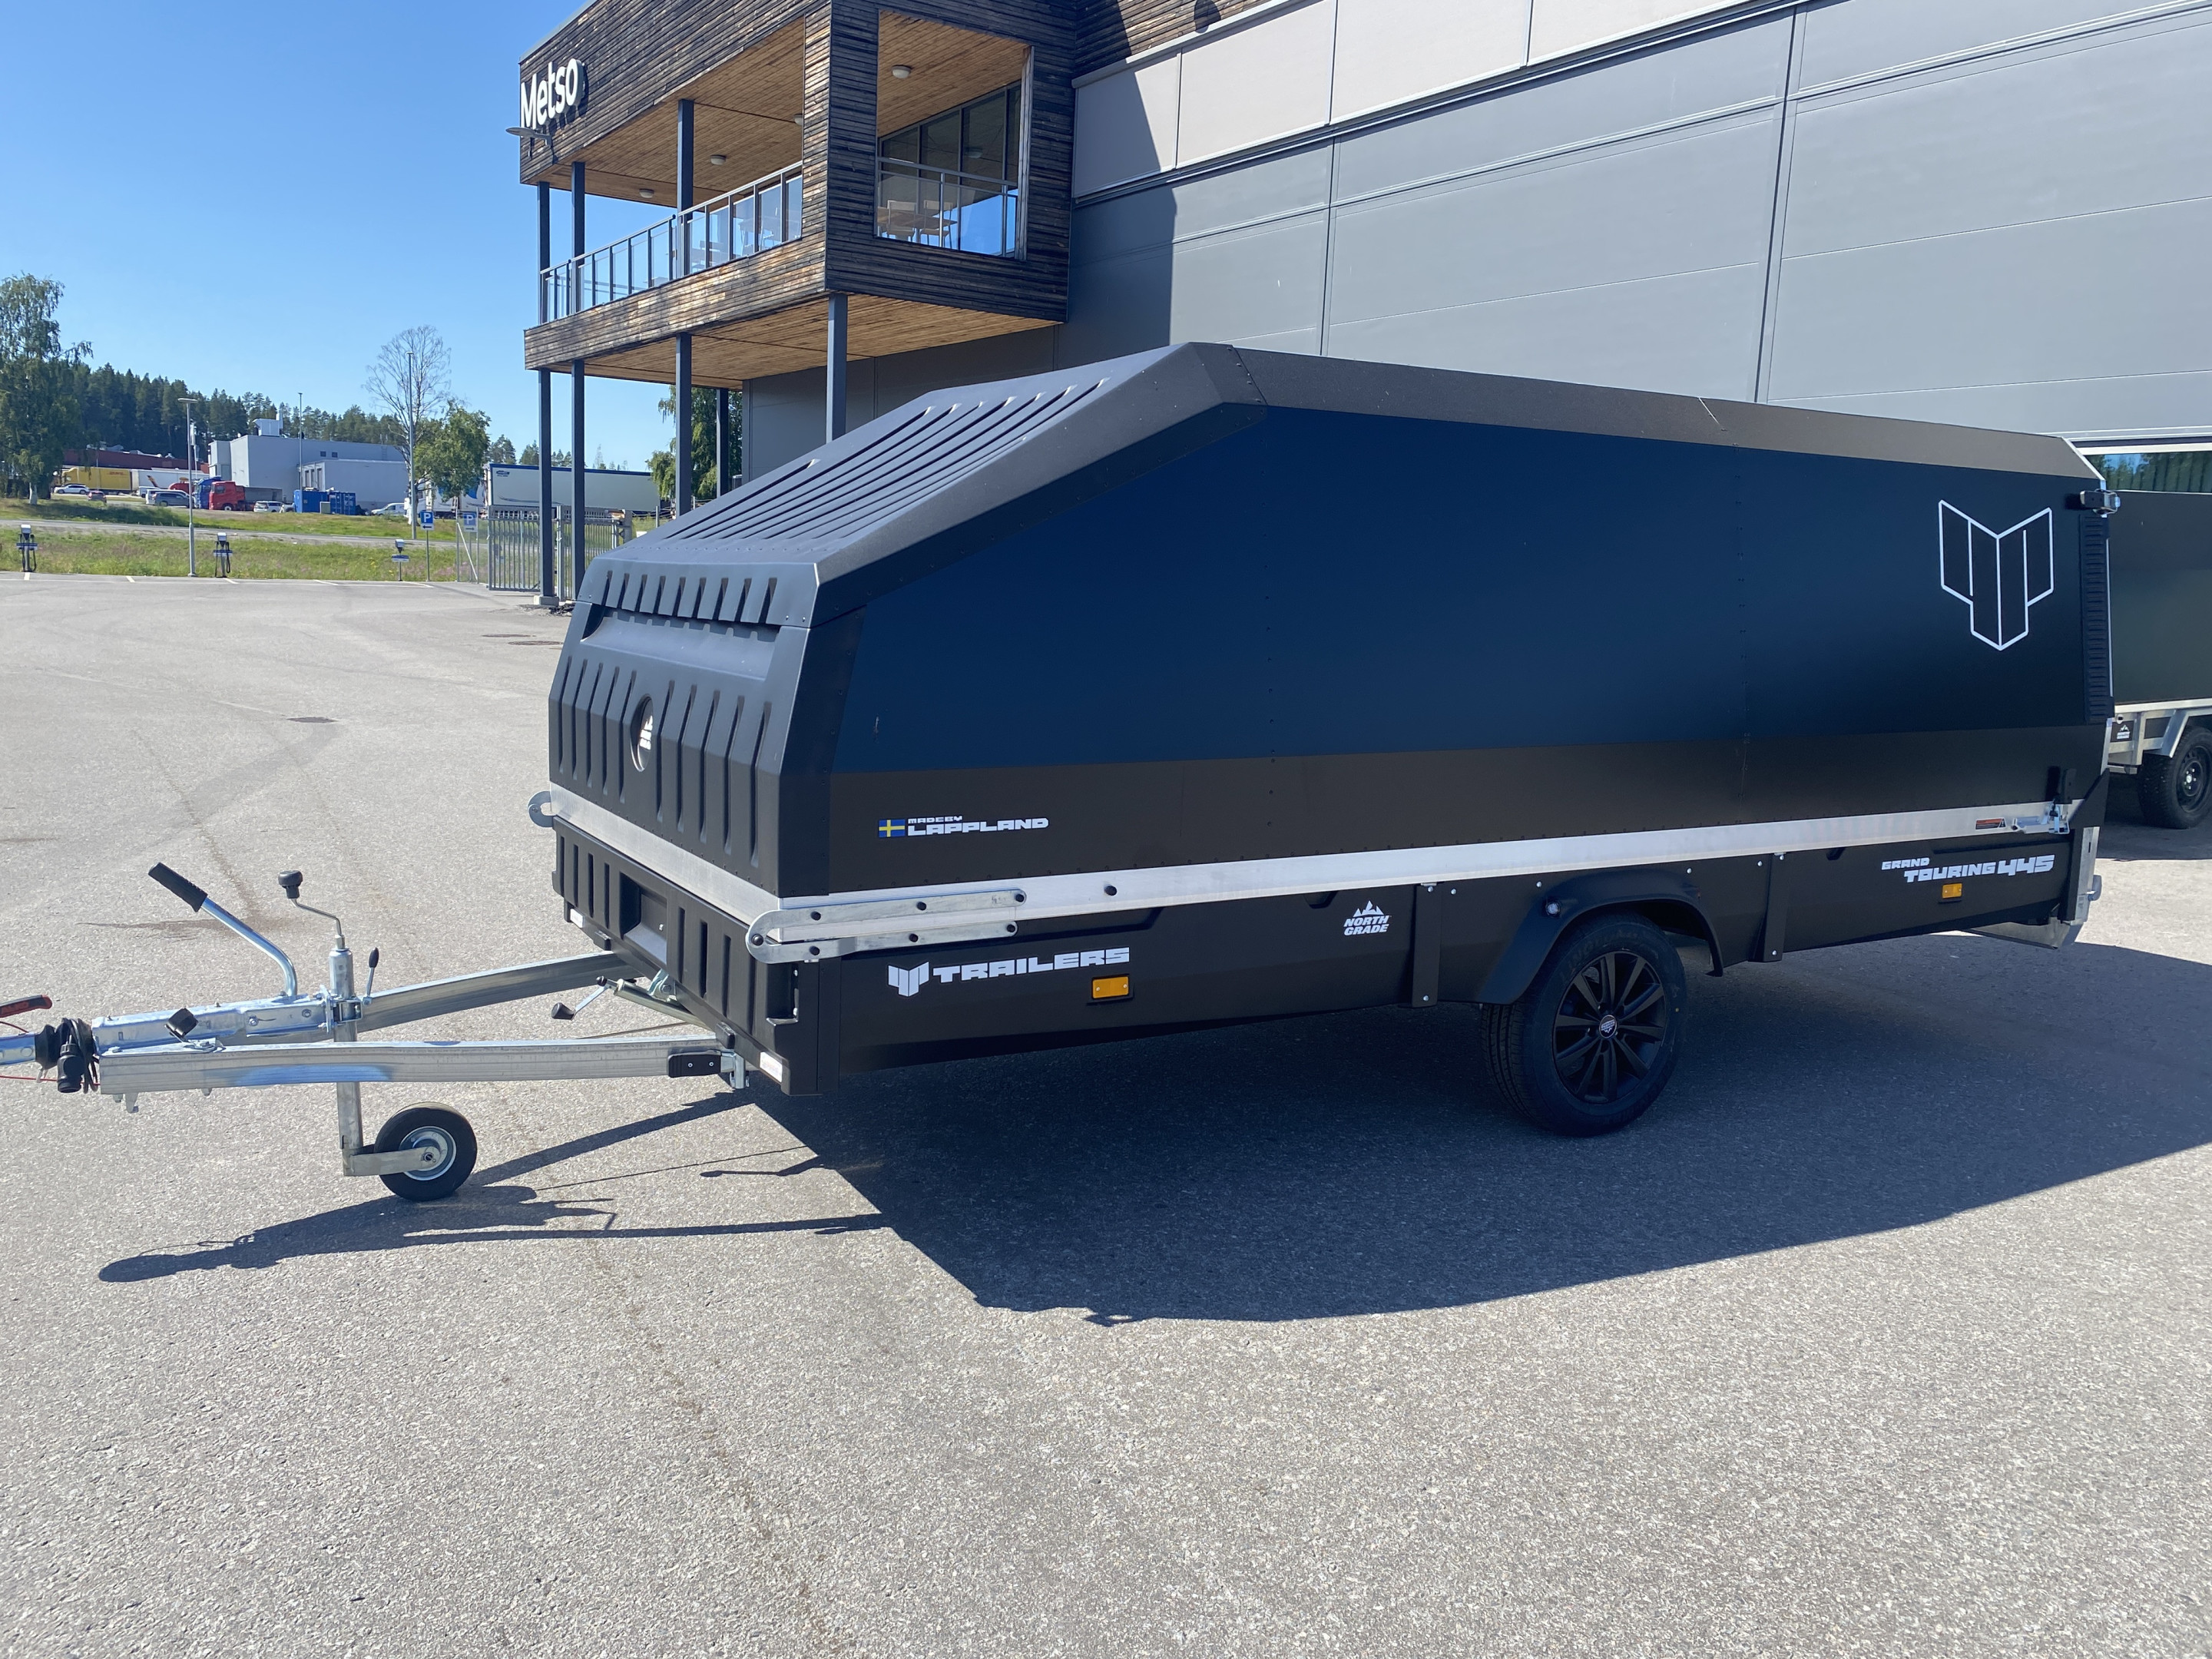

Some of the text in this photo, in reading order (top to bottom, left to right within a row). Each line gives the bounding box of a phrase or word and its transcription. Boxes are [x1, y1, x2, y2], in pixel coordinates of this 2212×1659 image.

[521, 58, 578, 130] Metso
[423, 512, 431, 522] P
[466, 515, 474, 524] P
[908, 818, 1048, 836] LAPPLAND
[1882, 857, 1929, 870] GRAND
[1904, 855, 2055, 882] TOURING 445
[1343, 915, 1390, 927] NORTH
[1344, 924, 1389, 935] GRADE
[932, 947, 1130, 983] TRAILERS
